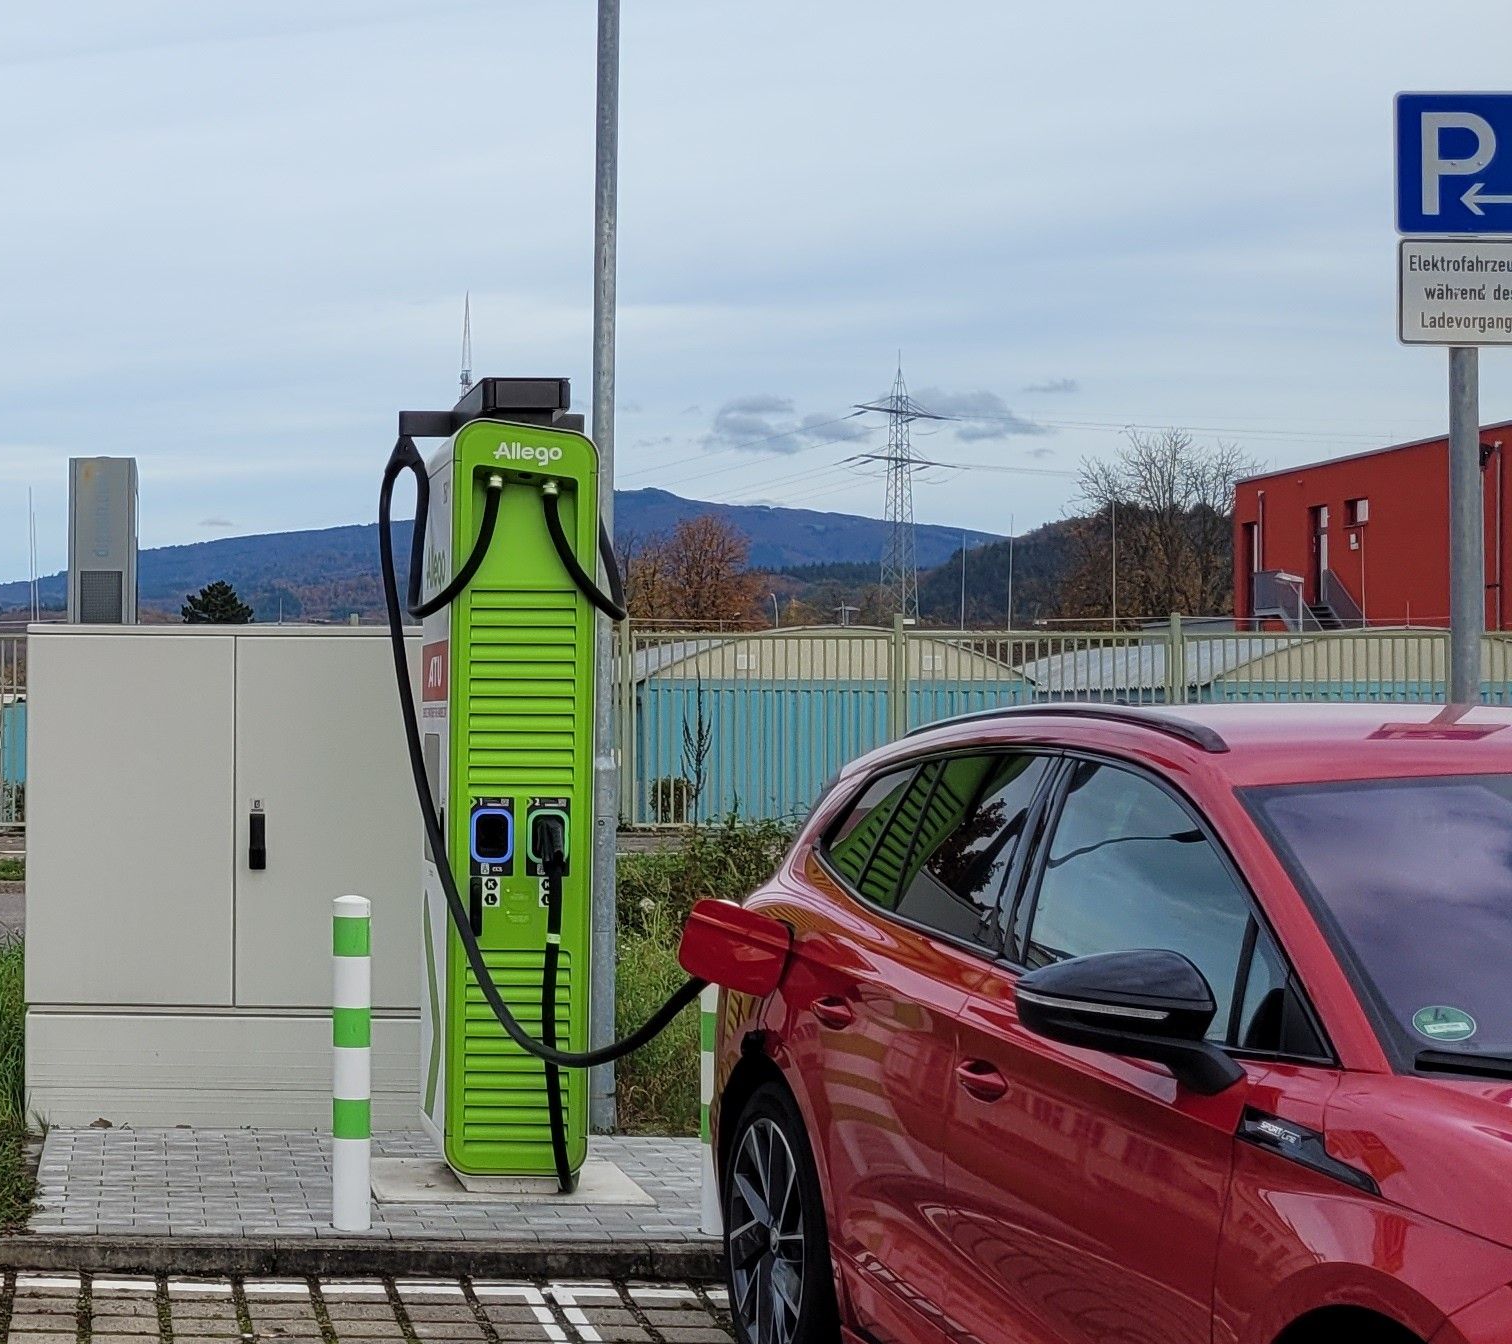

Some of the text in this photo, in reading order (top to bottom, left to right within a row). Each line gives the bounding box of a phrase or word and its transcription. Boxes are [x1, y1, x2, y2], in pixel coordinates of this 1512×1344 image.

[1420, 112, 1497, 216] P
[1424, 283, 1512, 301] während de
[493, 441, 563, 467] Allego
[428, 655, 443, 688] ATU
[487, 880, 495, 889] K
[488, 896, 495, 904] L
